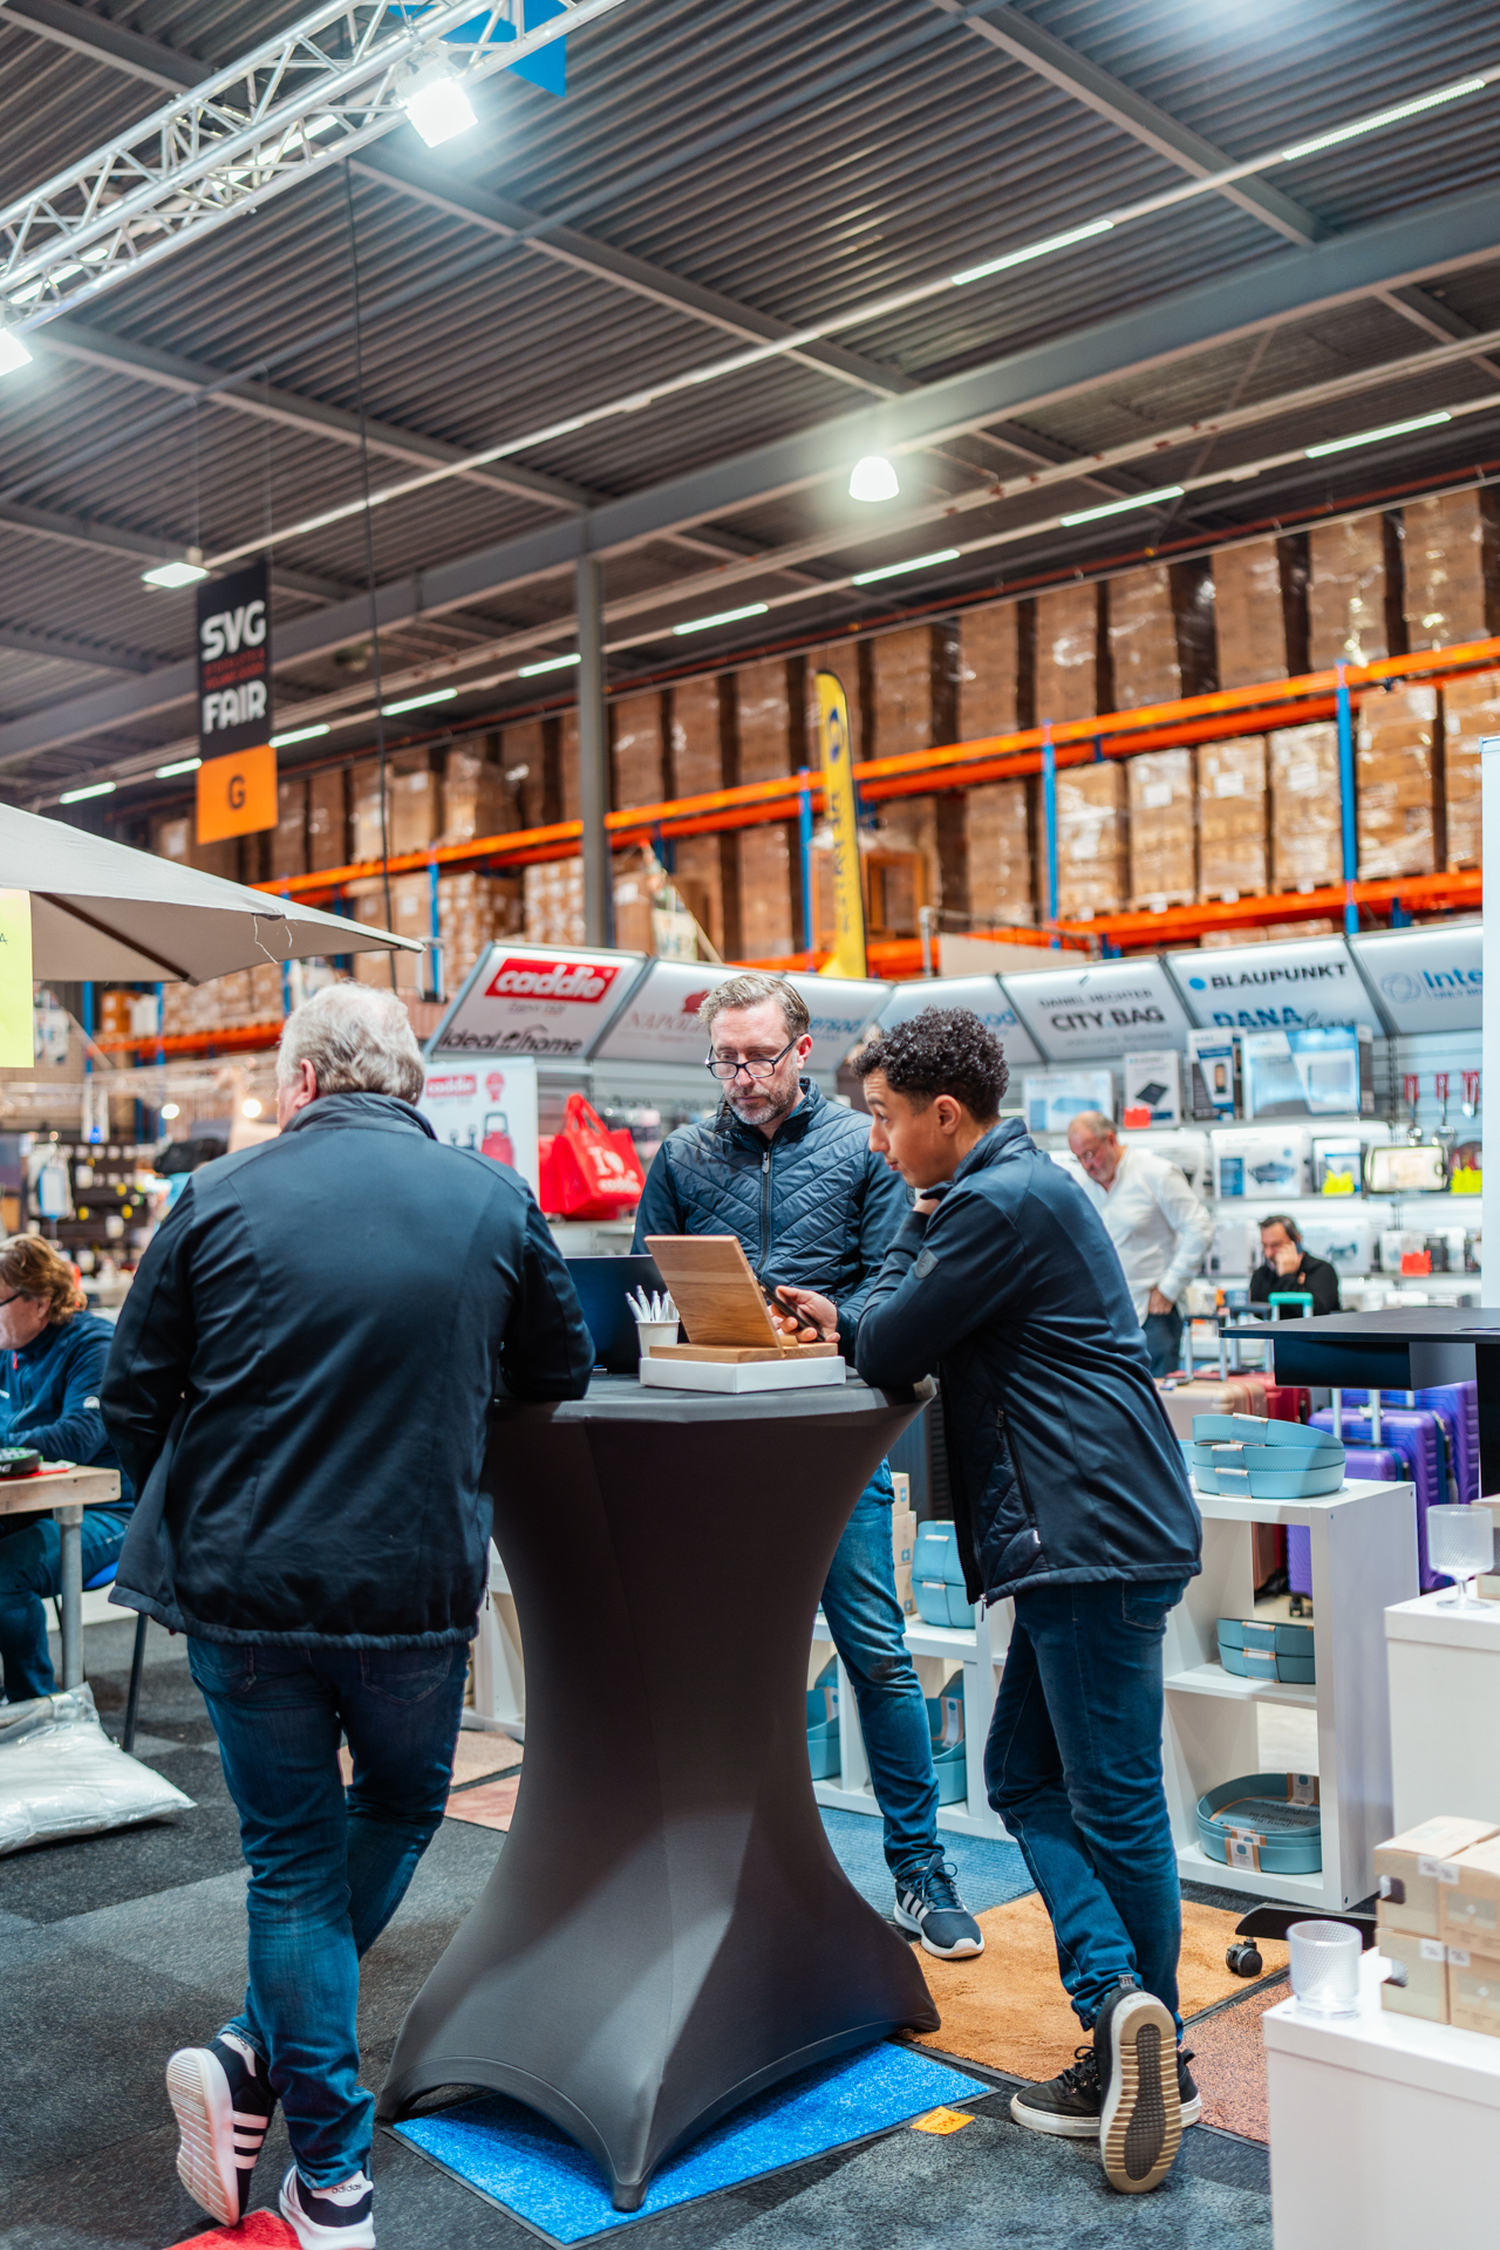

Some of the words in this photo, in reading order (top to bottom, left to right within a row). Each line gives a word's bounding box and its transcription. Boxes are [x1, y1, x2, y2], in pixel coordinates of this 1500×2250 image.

[201, 600, 266, 661] SVG
[203, 680, 267, 734] FAIR
[228, 774, 246, 811] G
[494, 964, 606, 998] caddie
[1211, 962, 1349, 989] BLAUPUNKT
[1213, 1006, 1303, 1027] DANA
[441, 1028, 499, 1051] ideal
[521, 1029, 583, 1054] home
[332, 2184, 362, 2194] adidas
